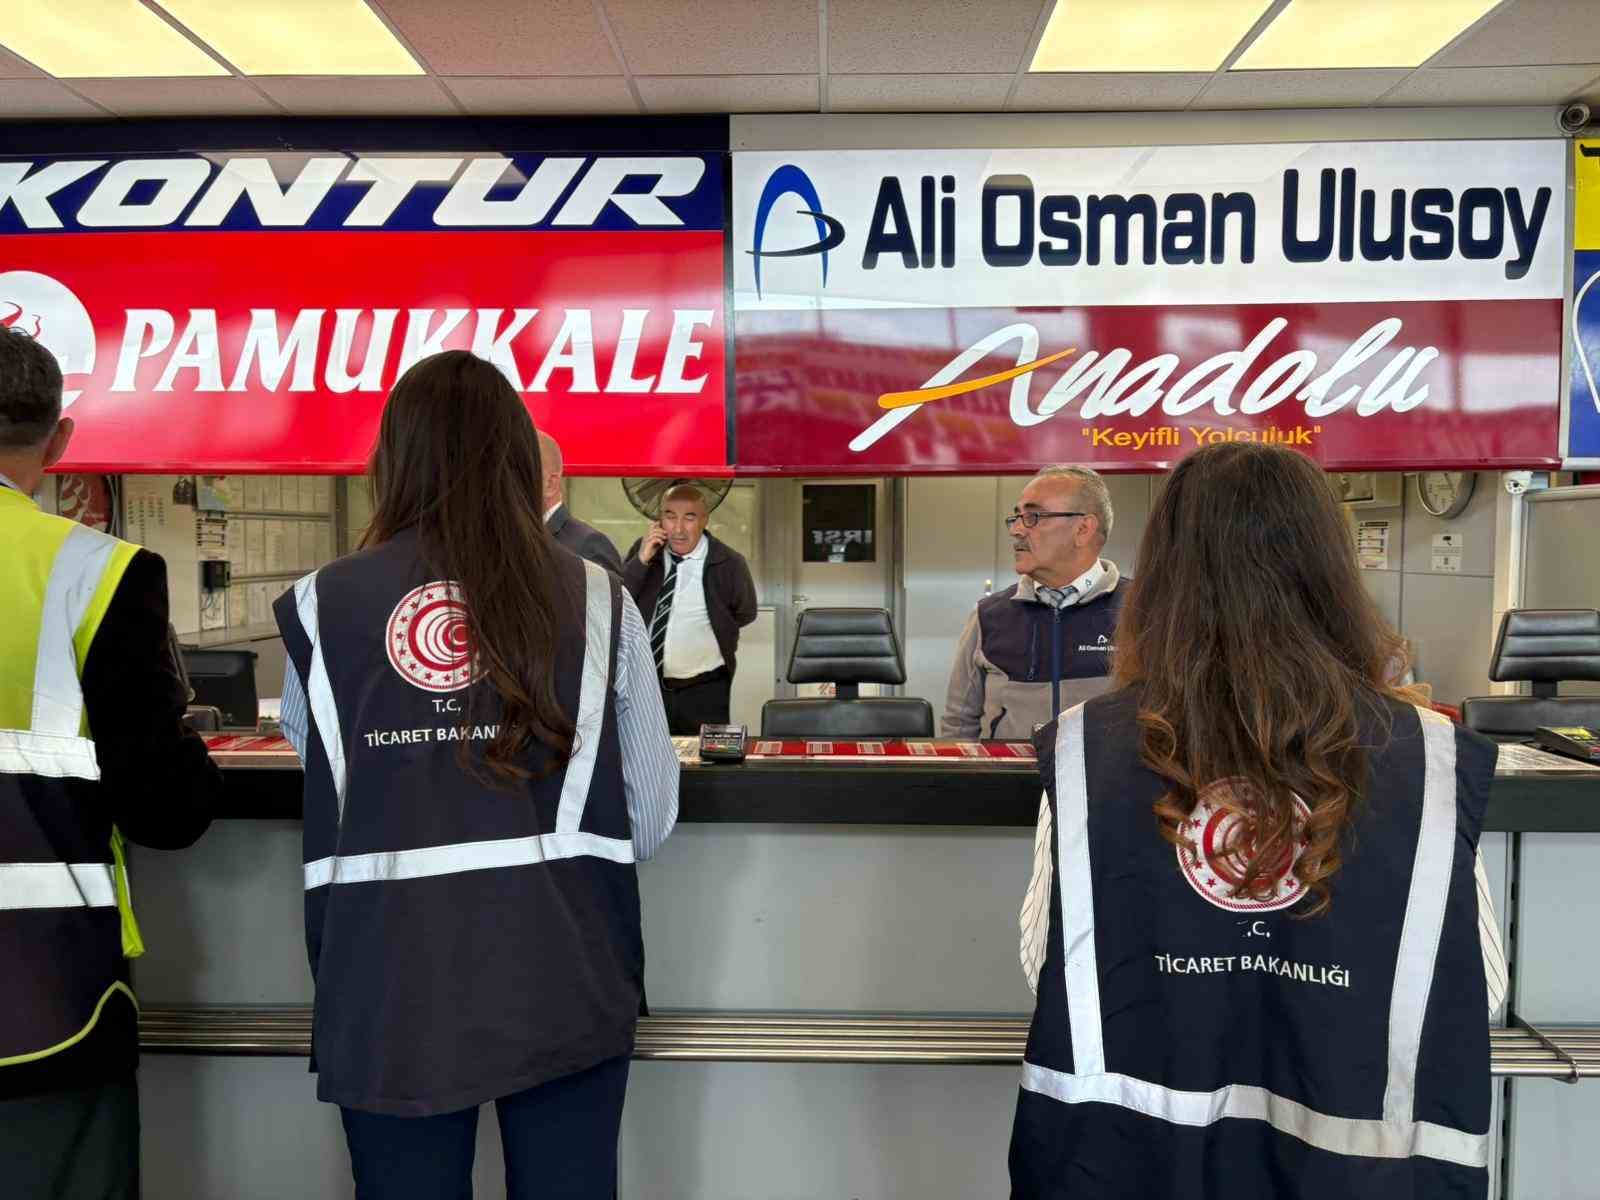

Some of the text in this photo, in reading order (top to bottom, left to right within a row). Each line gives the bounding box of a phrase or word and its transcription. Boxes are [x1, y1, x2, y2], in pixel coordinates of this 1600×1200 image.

[0, 157, 706, 227] KONTUR
[862, 167, 1552, 280] Ali Osman Ulusoy
[109, 308, 713, 395] PAMUKKALE
[848, 317, 1440, 452] Anadolu
[1082, 427, 1180, 449] "Keyifli
[431, 698, 462, 713] T.C.
[364, 725, 500, 747] TİCARET BAKAN
[1154, 953, 1351, 988] TİCARET BAKANLIĞI
